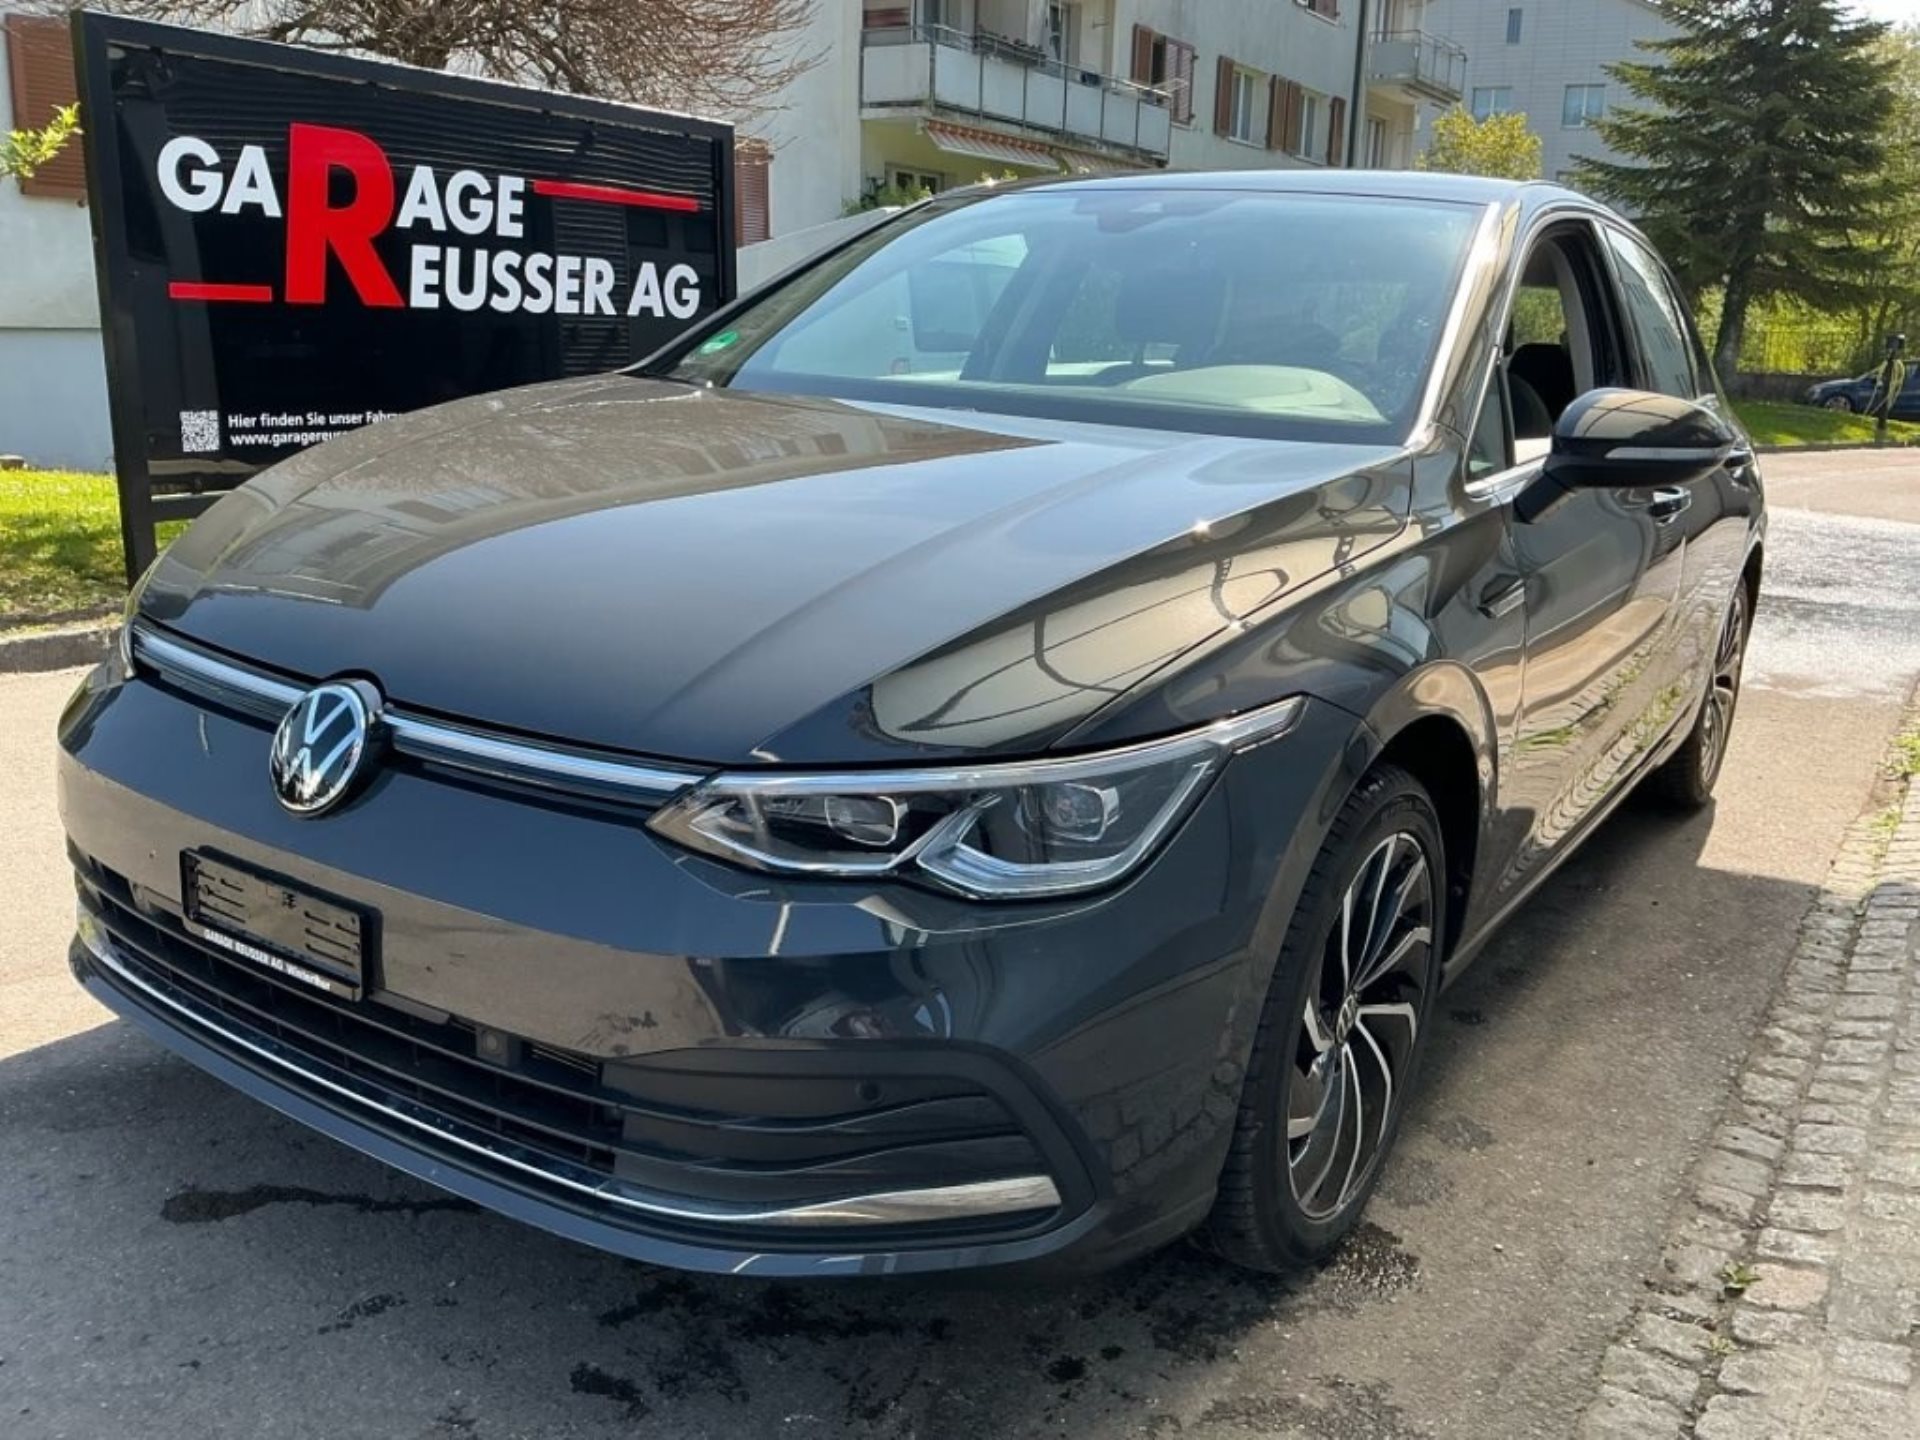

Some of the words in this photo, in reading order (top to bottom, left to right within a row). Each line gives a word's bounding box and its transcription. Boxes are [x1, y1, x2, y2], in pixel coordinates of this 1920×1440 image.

[157, 122, 525, 307] GARAGE
[627, 261, 699, 319] AG
[228, 413, 257, 428] Hier
[260, 411, 304, 427] finden
[306, 411, 326, 426] Sie
[329, 412, 364, 425] unser
[366, 409, 398, 424] Fahr
